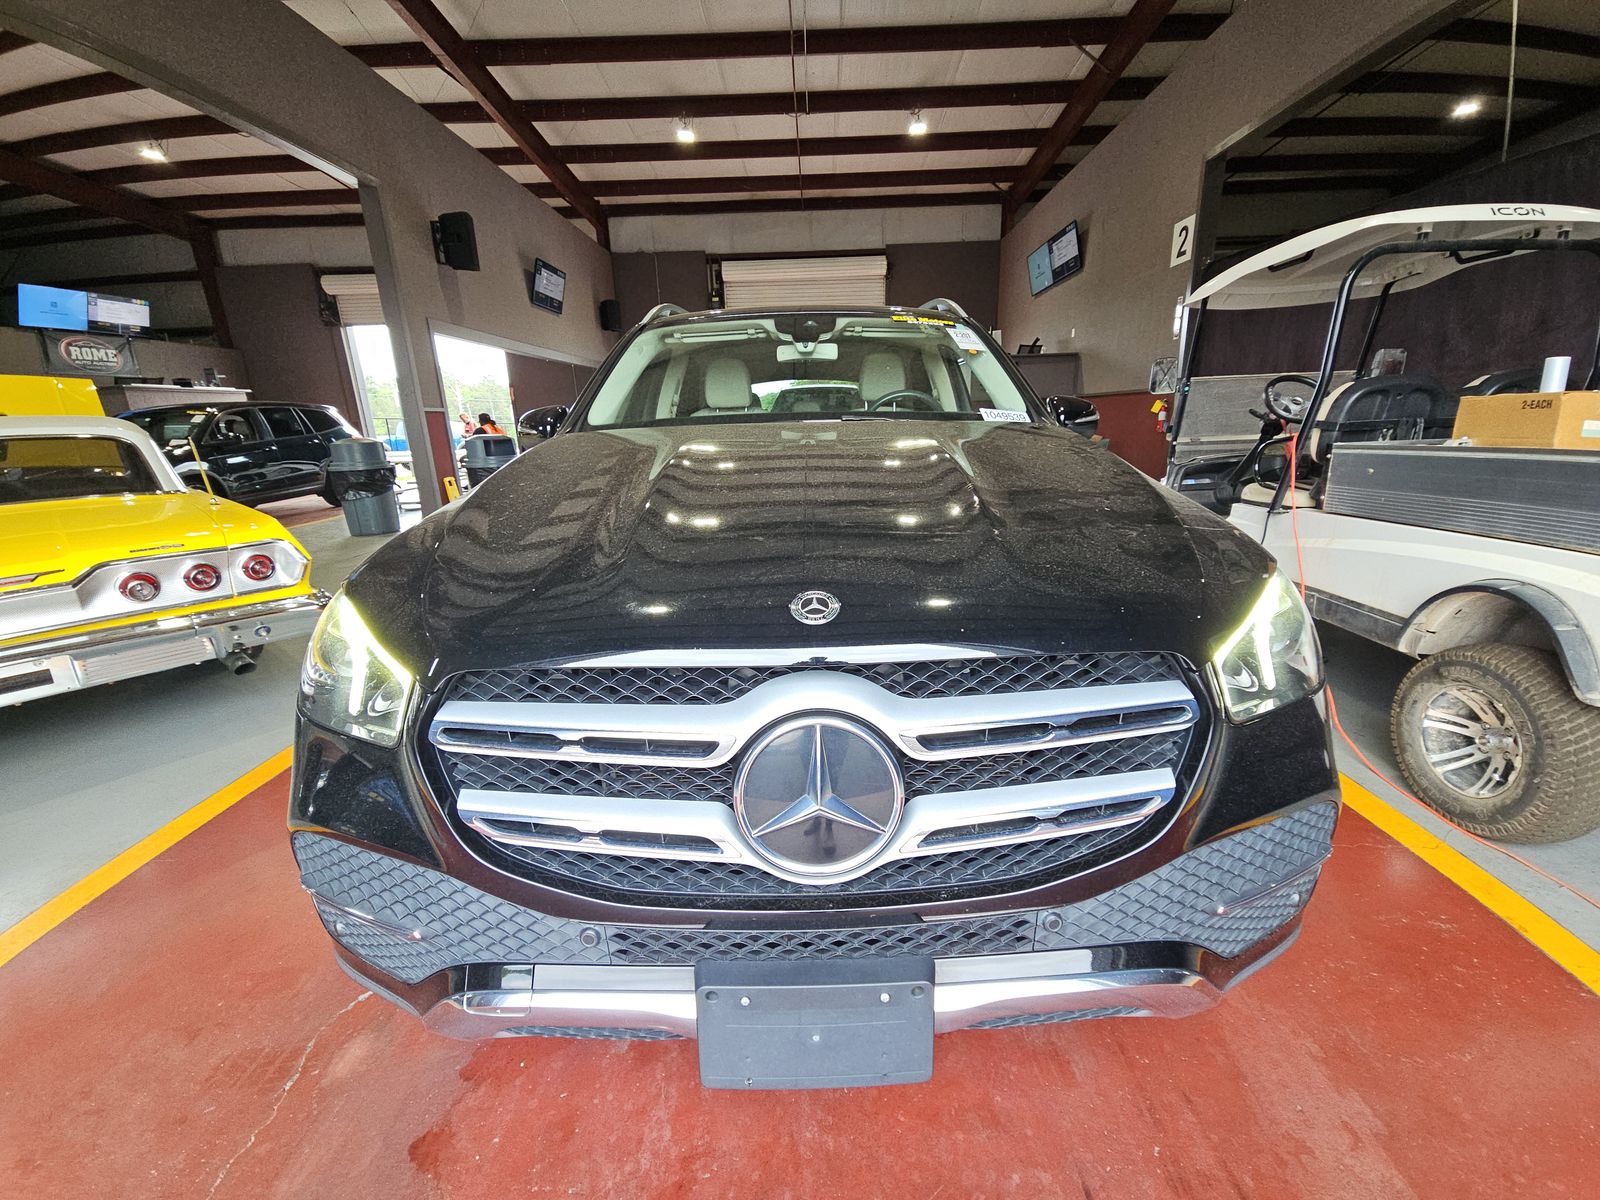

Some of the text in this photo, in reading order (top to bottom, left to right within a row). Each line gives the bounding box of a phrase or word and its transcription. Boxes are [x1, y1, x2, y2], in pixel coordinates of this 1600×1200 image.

[1490, 207, 1546, 216] ICON
[1176, 225, 1189, 259] 2
[69, 346, 118, 362] ROME
[1521, 400, 1553, 410] 2-EACH
[984, 411, 1027, 422] 1049539
